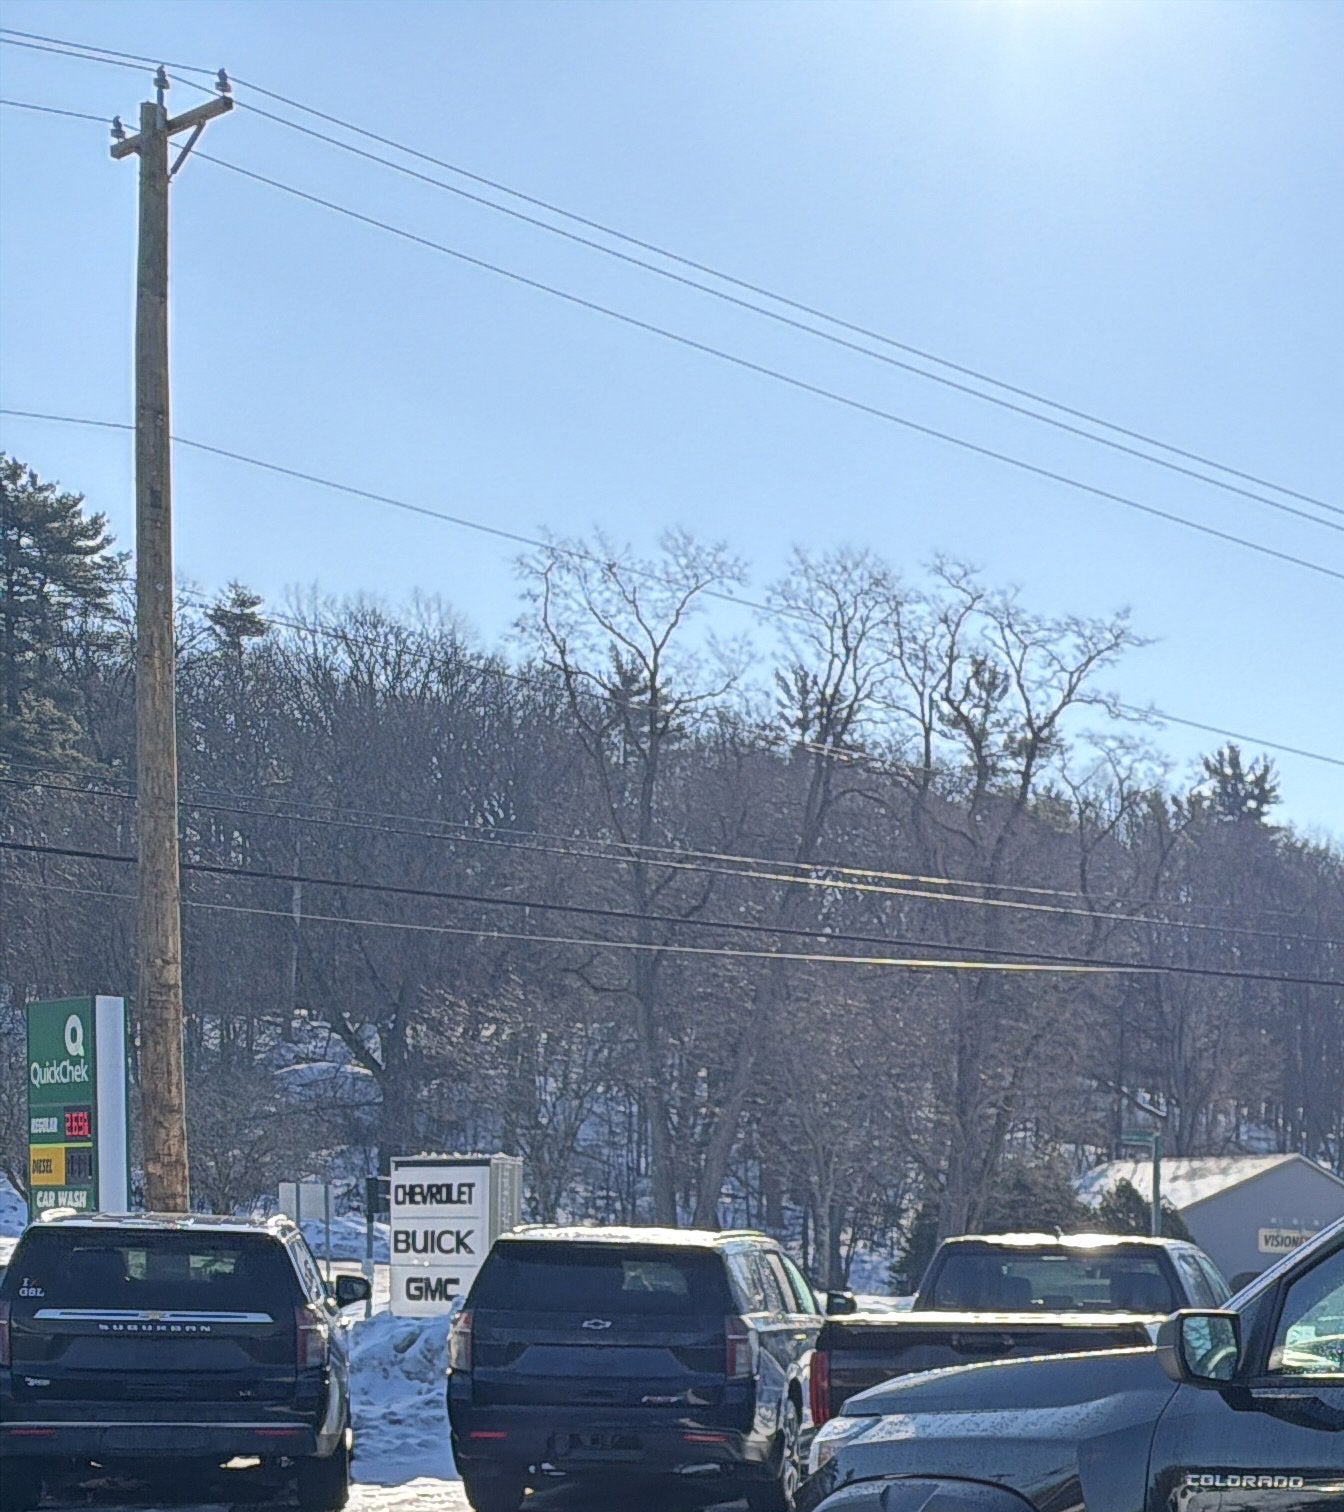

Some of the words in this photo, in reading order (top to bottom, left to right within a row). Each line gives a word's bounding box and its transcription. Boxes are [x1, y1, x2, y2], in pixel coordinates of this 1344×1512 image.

[30, 1059, 89, 1088] QuickChek
[32, 1158, 53, 1174] DIESEL
[36, 1190, 56, 1208] CAR
[57, 1190, 87, 1208] WASH
[394, 1182, 475, 1205] CHEVROLET
[393, 1229, 475, 1254] BUICK
[405, 1276, 460, 1301] GMC
[1184, 1474, 1304, 1489] COLORADO
